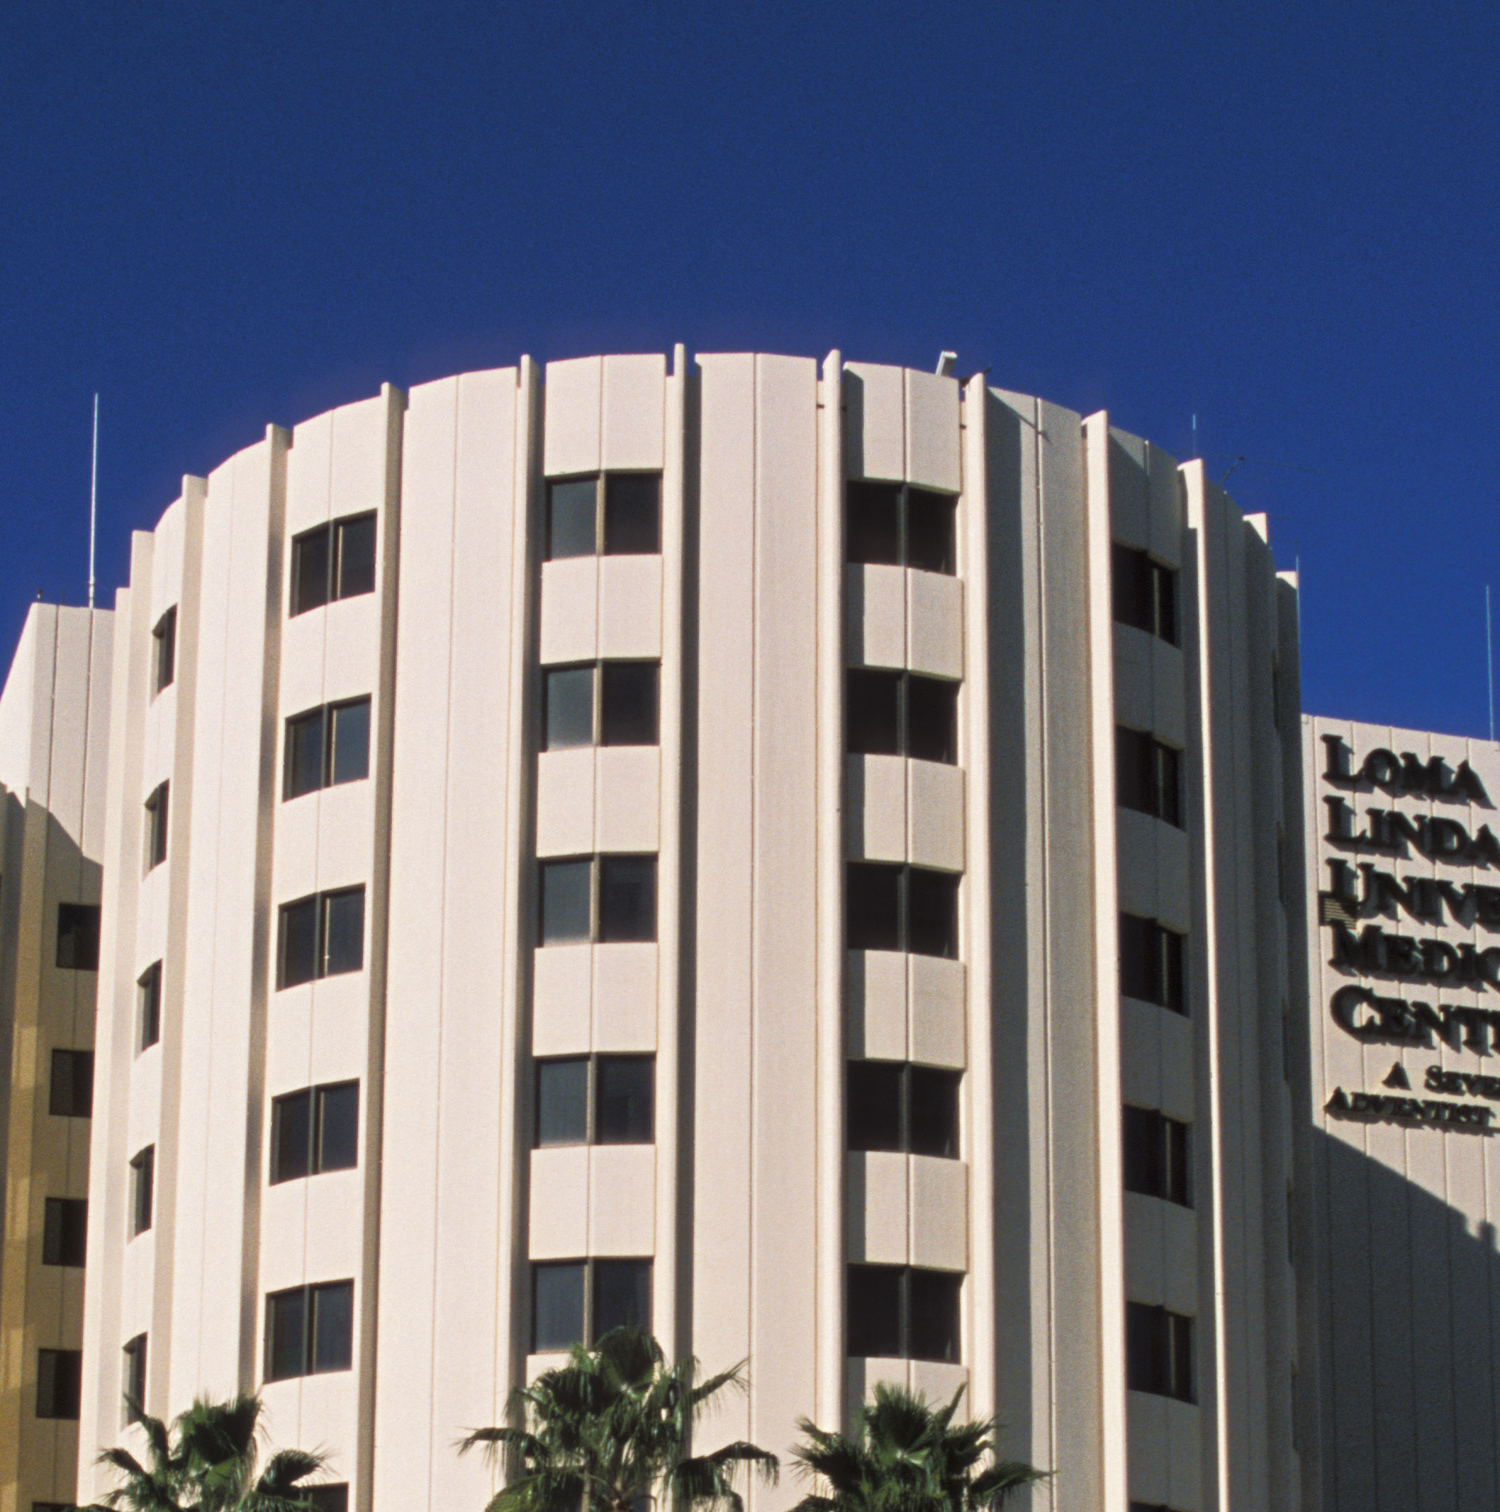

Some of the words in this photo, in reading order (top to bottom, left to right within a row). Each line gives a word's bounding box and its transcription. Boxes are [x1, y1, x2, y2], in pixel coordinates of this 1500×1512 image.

[1321, 734, 1492, 806] LOMA
[1382, 1061, 1411, 1090] A
[1323, 1086, 1495, 1133] ADVENTIST
